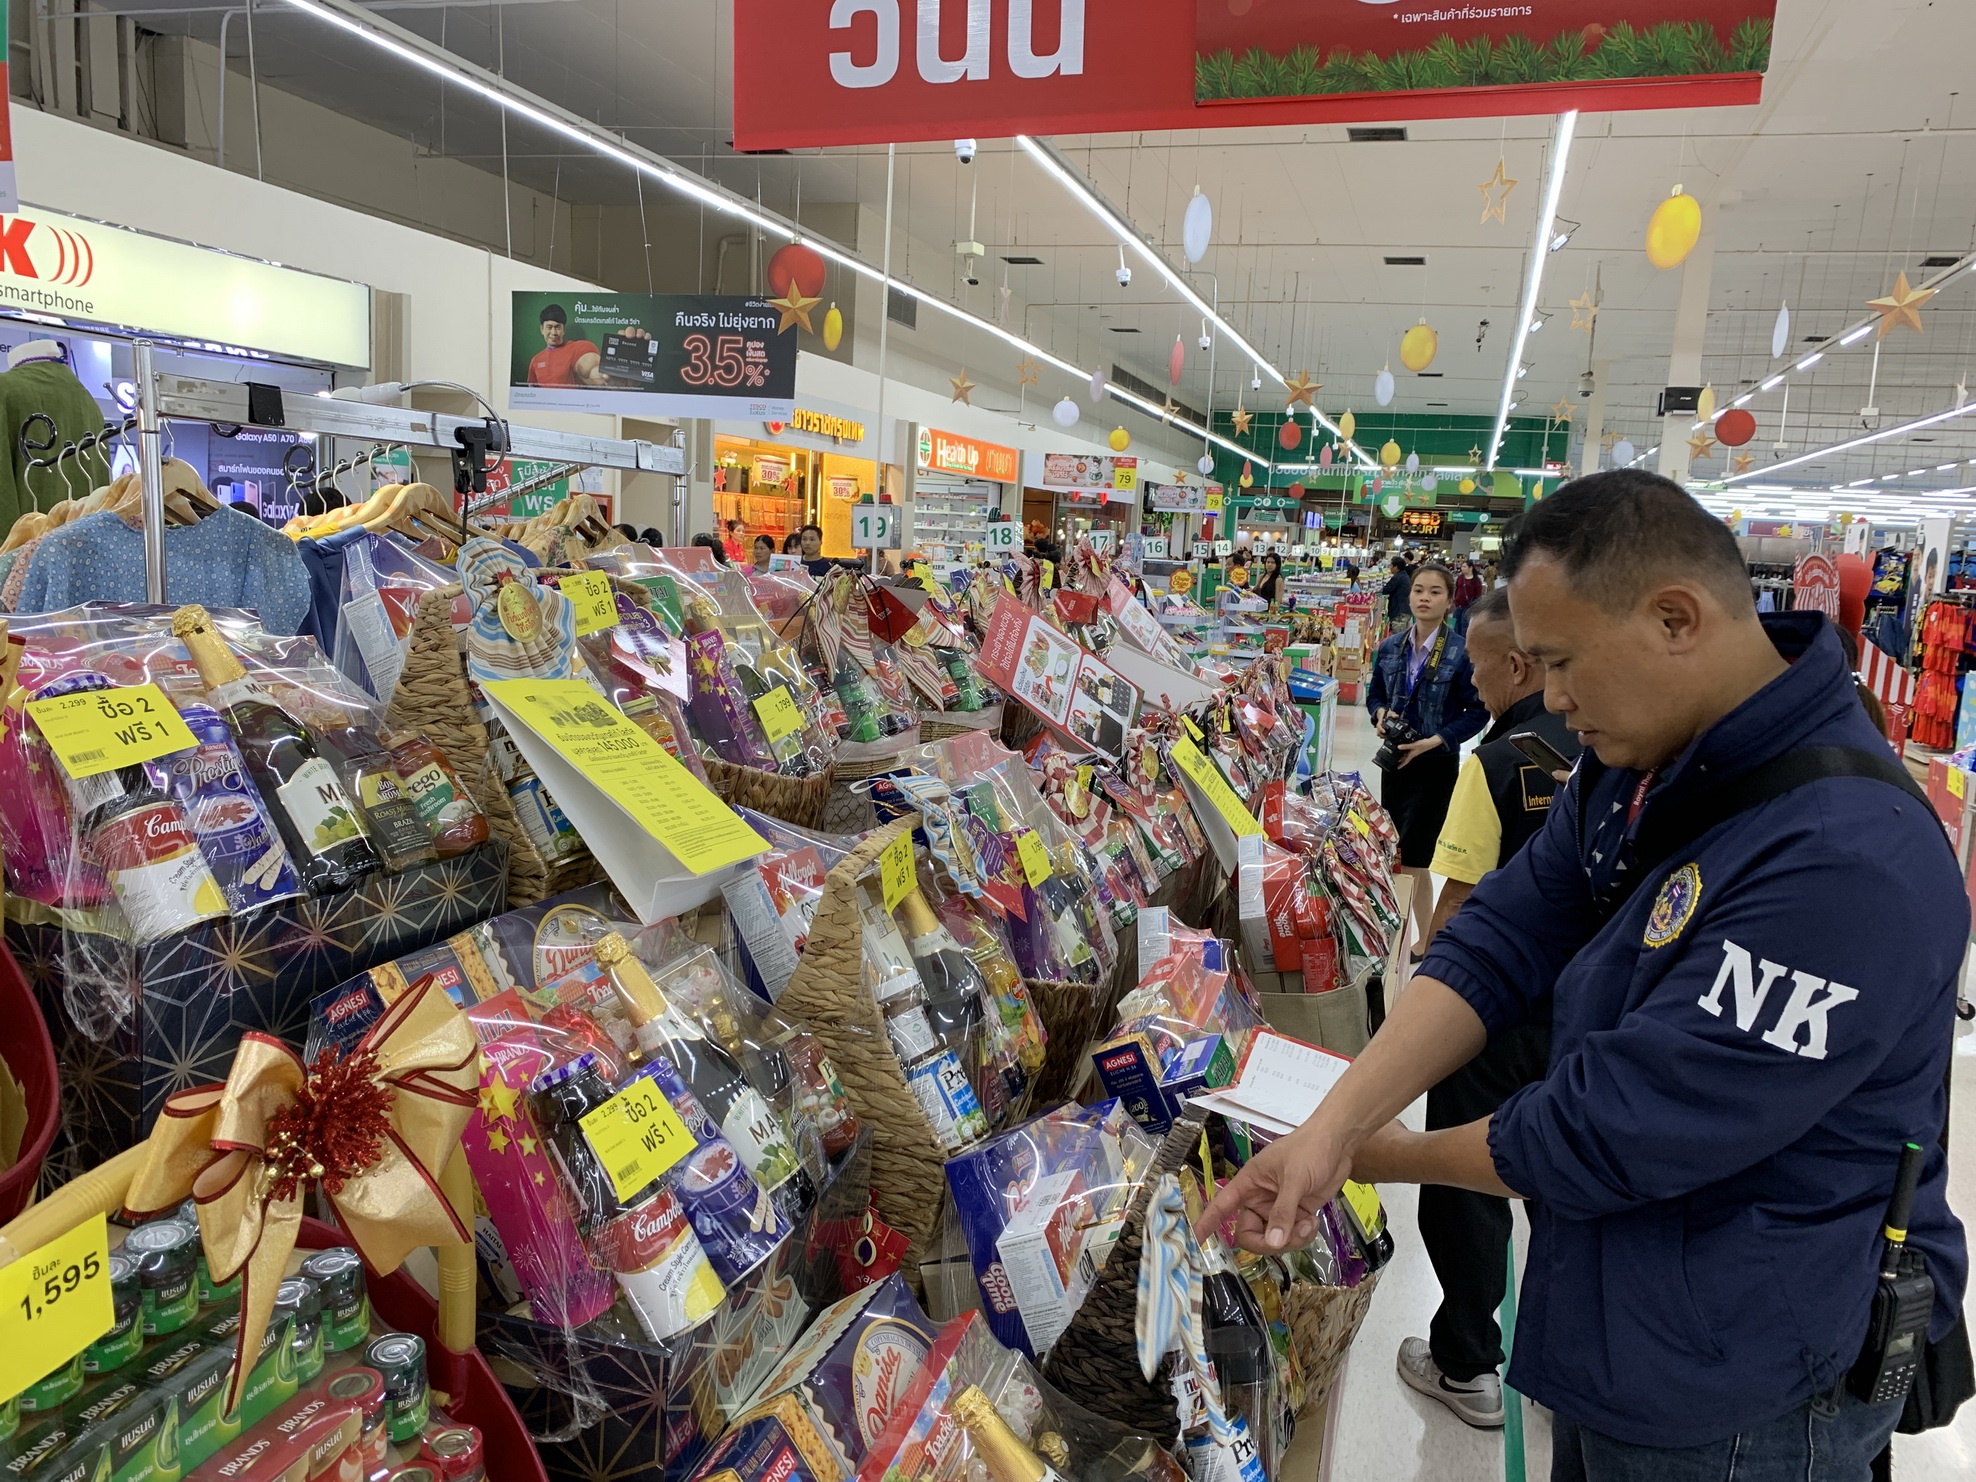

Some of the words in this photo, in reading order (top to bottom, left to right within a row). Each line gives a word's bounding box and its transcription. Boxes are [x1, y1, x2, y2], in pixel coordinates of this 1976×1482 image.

[1401, 4, 1532, 23] เฉพาะสินค้าที่ร่วมรายการ
[675, 312, 716, 327] คืนจริง
[718, 312, 775, 331] ไม่ยุ่งยาก
[641, 370, 654, 379] VISA
[236, 432, 262, 444] Galaxy
[263, 433, 277, 442] A50
[280, 434, 294, 444] A70
[967, 444, 979, 474] Up
[761, 470, 780, 483] 30%
[1119, 474, 1131, 485] 79
[1210, 499, 1219, 507] 79
[859, 516, 887, 539] 19
[1402, 512, 1441, 525] FOOD
[989, 527, 1013, 546] 18
[1090, 535, 1108, 550] 17
[1147, 541, 1163, 554] 16
[1194, 544, 1208, 556] 15
[1216, 543, 1229, 553] 14
[1254, 544, 1266, 553] 13
[1276, 545, 1286, 554] 12
[585, 578, 600, 598] ซื้อ
[601, 581, 609, 594] 2
[592, 600, 607, 617] ฟรี
[607, 601, 614, 613] 1
[1430, 650, 1440, 668] Nikon
[60, 698, 87, 710] 2,299
[97, 695, 134, 719] ซื้อ
[137, 697, 155, 713] 2
[774, 697, 791, 713] 1,799
[115, 721, 153, 746] ฟรี
[155, 721, 170, 737] 1
[407, 769, 441, 794] rego
[1633, 785, 1646, 806] Royal
[1640, 771, 1654, 786] Thai
[420, 795, 437, 810] Fresh
[903, 844, 908, 858] 2
[777, 858, 816, 891] Kellogg's
[1274, 913, 1287, 938] Time
[1281, 911, 1294, 937] Good
[329, 992, 367, 1020] AGNESI
[1697, 938, 1860, 1060] NK
[1105, 1053, 1135, 1070] AGNESI
[601, 1103, 619, 1118] 2,299
[621, 1096, 647, 1123] ซื้อ
[643, 1094, 658, 1112] 2
[733, 1104, 748, 1121] WHITE
[641, 1122, 666, 1153] ฟรี
[662, 1120, 675, 1137] 1
[482, 1227, 503, 1249] HAITAI
[32, 1259, 61, 1281] ชิ้นละ
[658, 1272, 674, 1292] Cream
[670, 1251, 684, 1269] Style
[681, 1241, 692, 1257] Corn
[20, 1250, 101, 1321] 1,595
[161, 1282, 188, 1298] แบรนด์
[981, 1275, 1007, 1313] Time
[989, 1263, 1018, 1309] Good
[337, 1302, 360, 1318] แบรนด์
[209, 1311, 241, 1335] BRAN
[187, 1370, 220, 1402] แบรนด์
[866, 1345, 902, 1440] Danisa
[397, 1393, 421, 1409] แบรนด์
[121, 1414, 156, 1449] แบรนด์
[315, 1427, 343, 1461] แบรนด์
